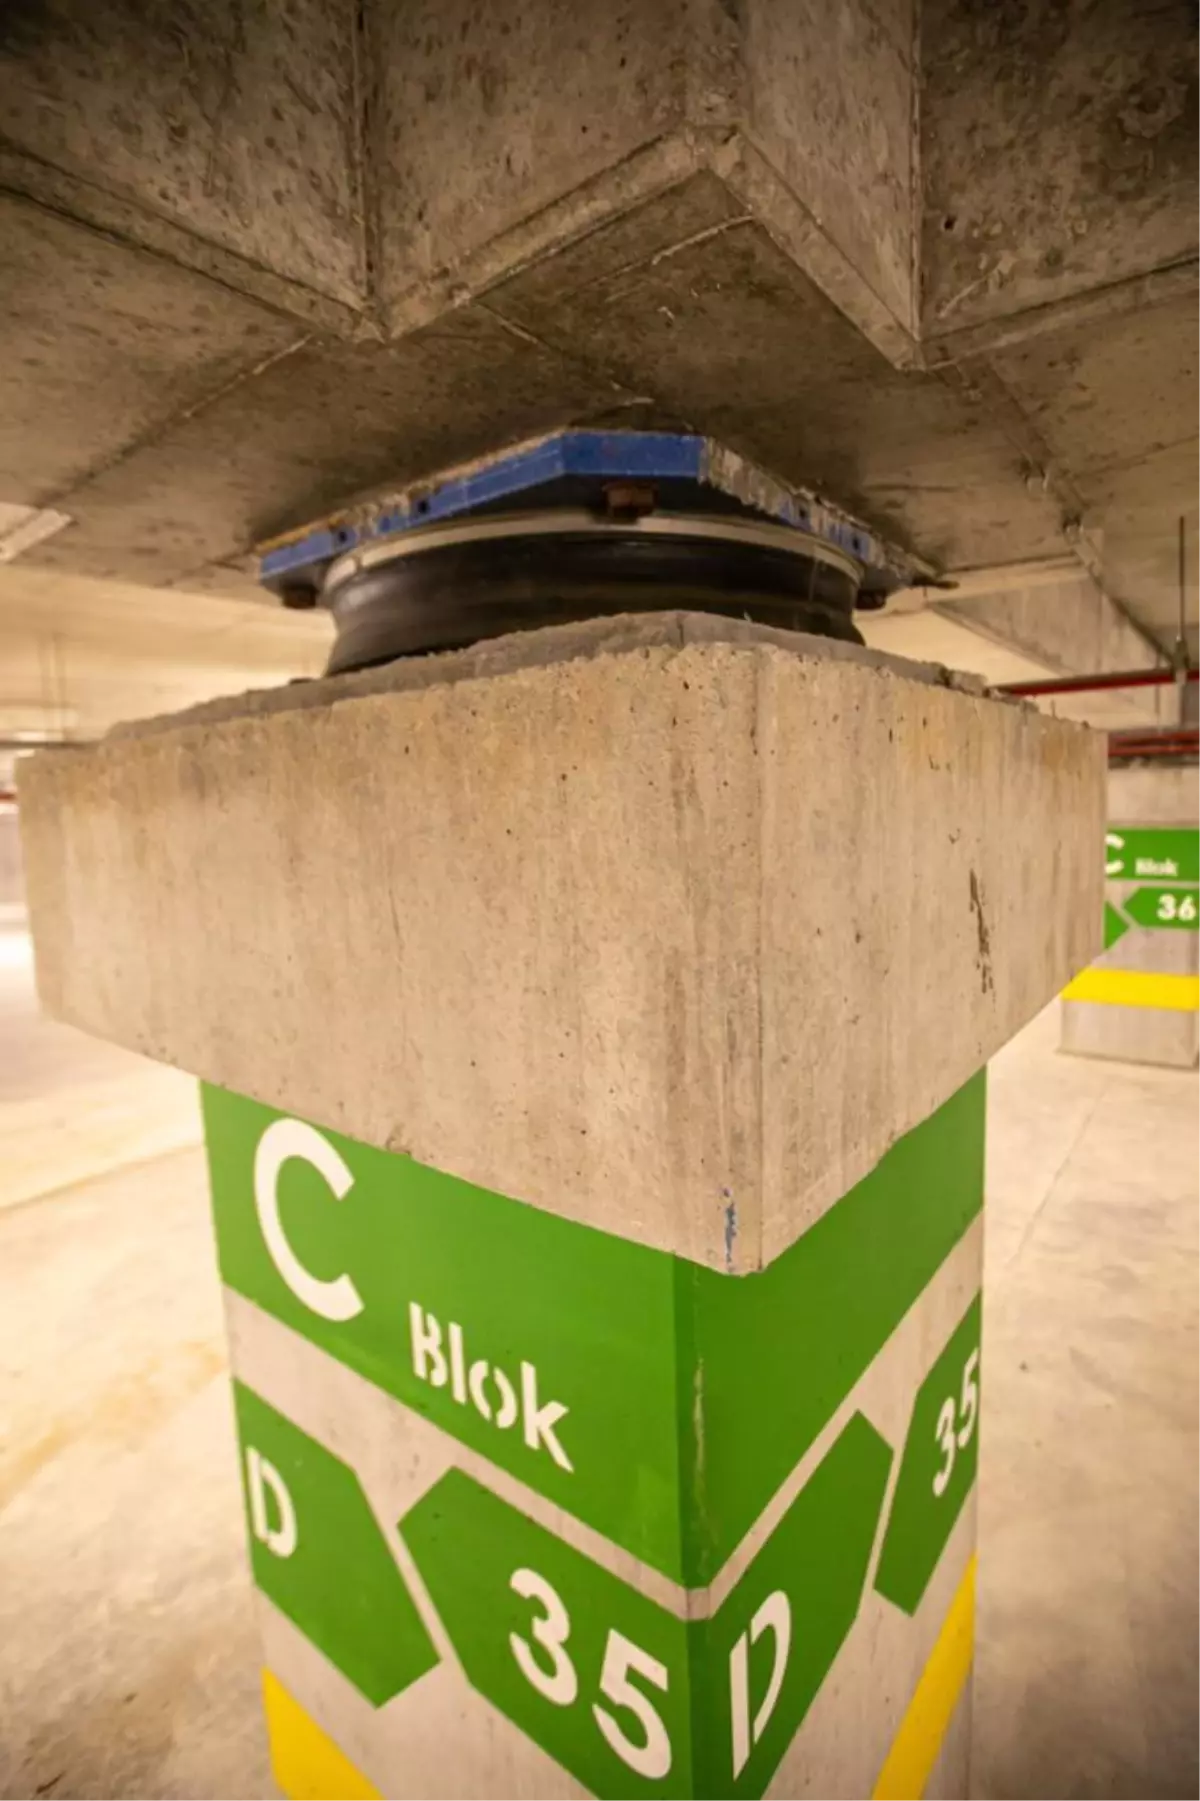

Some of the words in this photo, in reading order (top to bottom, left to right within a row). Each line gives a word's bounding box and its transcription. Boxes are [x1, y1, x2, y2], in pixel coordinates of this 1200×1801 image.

[1157, 894, 1196, 921] 36
[254, 1117, 364, 1322] C
[409, 1301, 573, 1473] Blok
[246, 1445, 298, 1558] D
[932, 1347, 978, 1498] 35
[510, 1568, 672, 1780] 35
[729, 1590, 792, 1782] D
